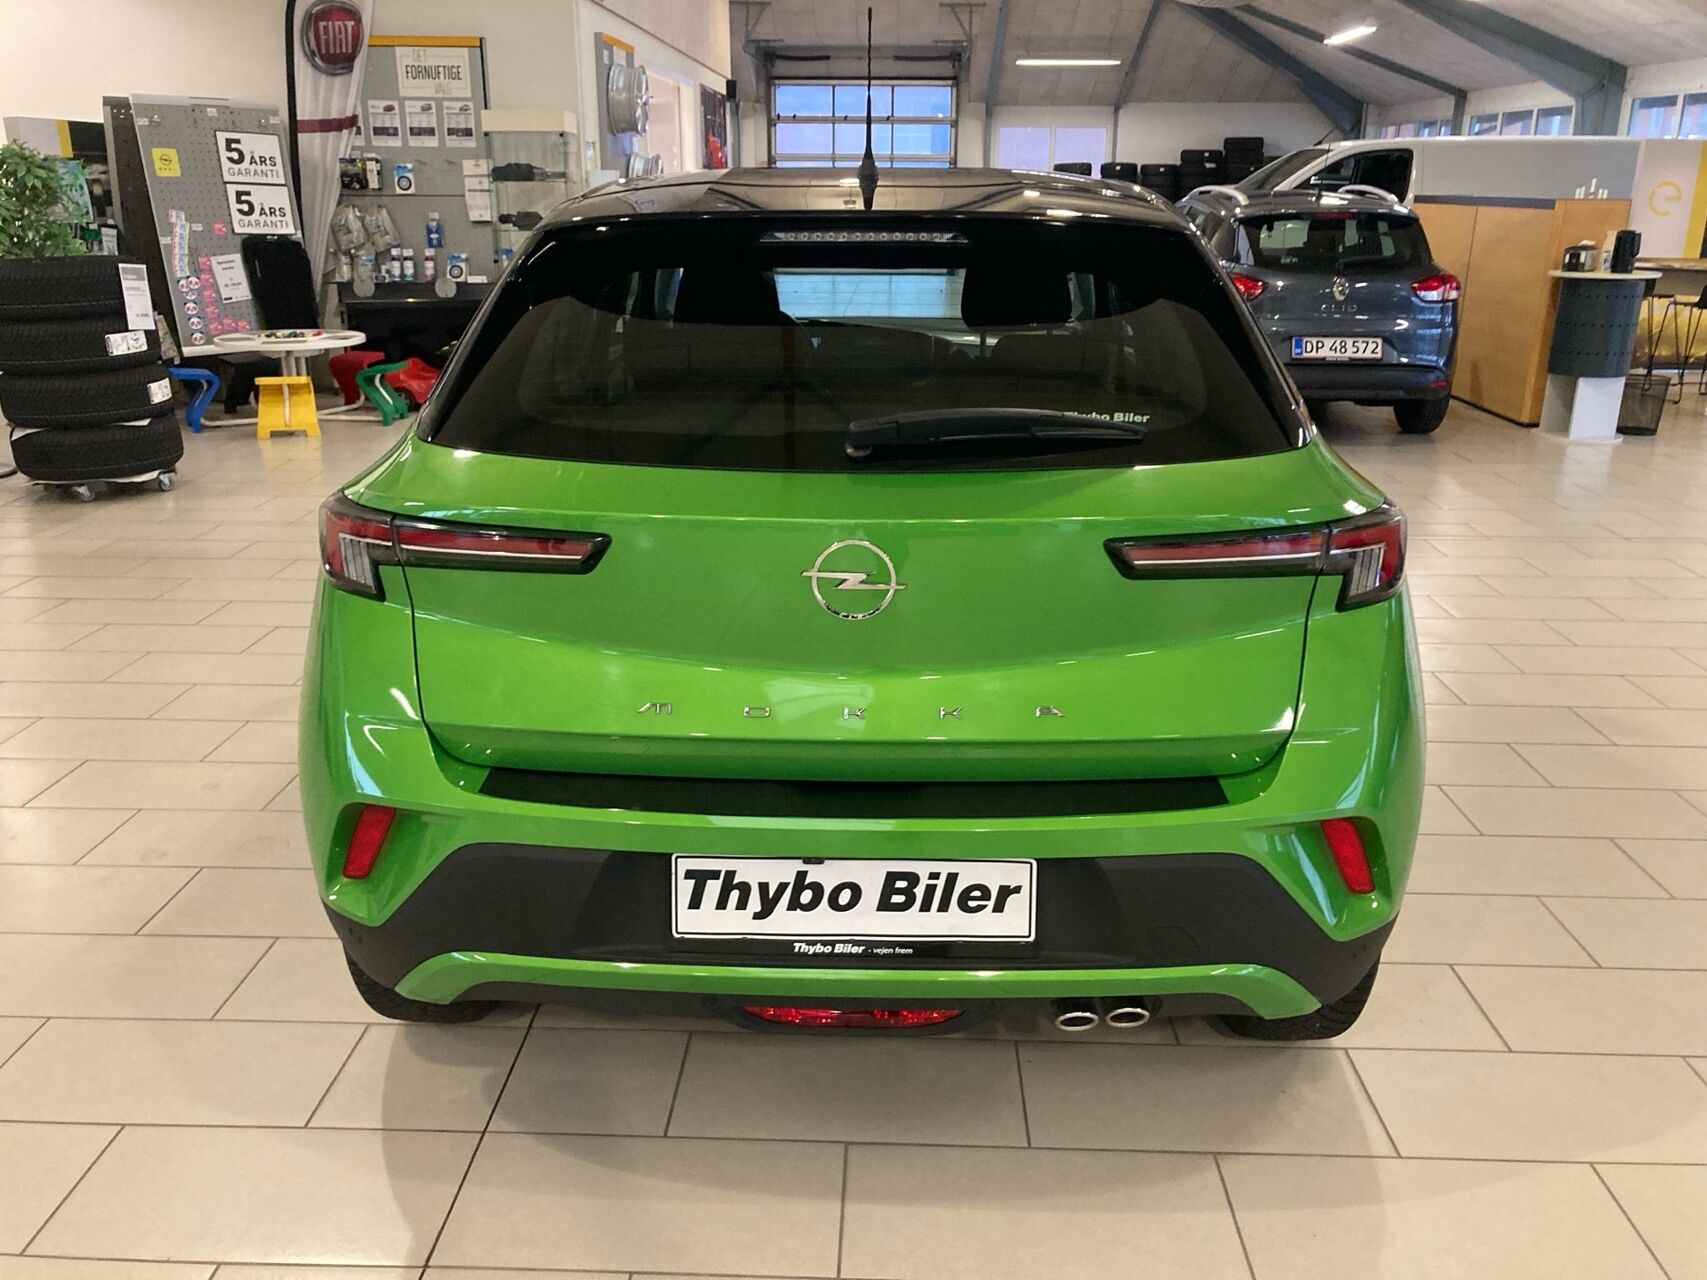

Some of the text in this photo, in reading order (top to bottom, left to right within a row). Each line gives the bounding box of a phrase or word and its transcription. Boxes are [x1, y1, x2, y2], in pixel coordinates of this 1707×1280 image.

[318, 20, 355, 54] FIAT
[405, 65, 462, 81] FORNUFTIGE
[225, 138, 277, 167] 5 ÅRS
[228, 167, 280, 179] GARANTI
[235, 190, 287, 218] 5 ÅRS
[238, 219, 289, 229] GARANTI
[1304, 340, 1379, 355] DP 48 572
[1113, 412, 1151, 423] Biler
[682, 869, 1023, 920] Thybo Biler
[792, 942, 833, 955] Thybo
[833, 943, 866, 954] Biler
[873, 947, 894, 955] vejen
[894, 946, 914, 954] frem
